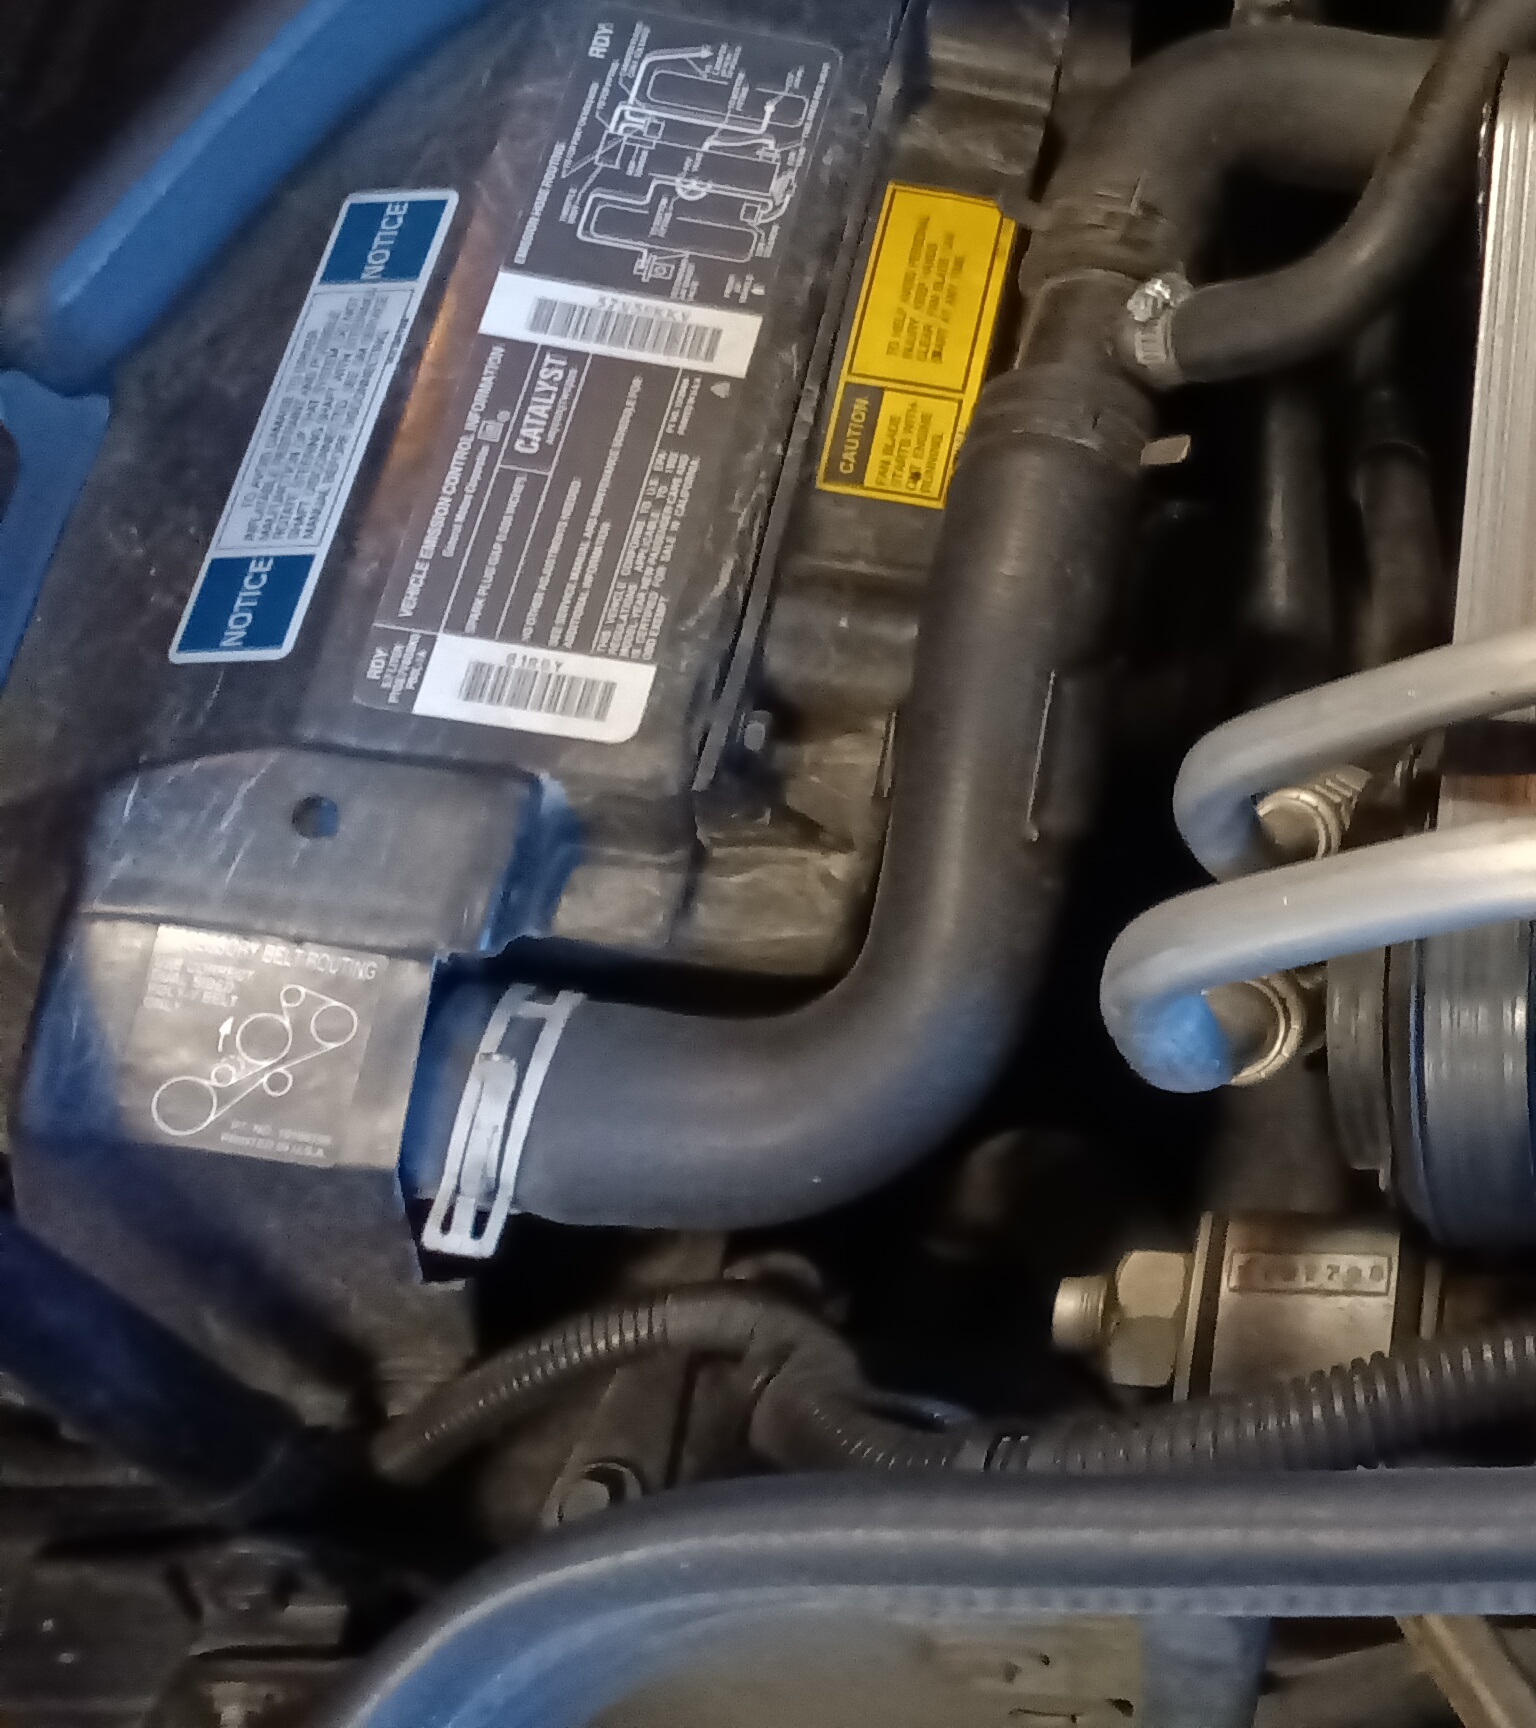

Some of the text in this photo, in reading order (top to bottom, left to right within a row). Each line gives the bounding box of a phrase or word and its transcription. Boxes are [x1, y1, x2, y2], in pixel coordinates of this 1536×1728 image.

[586, 20, 616, 59] RDY
[359, 201, 410, 280] NOTICE
[512, 352, 569, 455] CATALYST
[837, 397, 870, 474] CAUTION
[910, 411, 933, 459] ENGINE
[397, 560, 430, 617] VEHICLE
[417, 496, 453, 559] EMISSION
[440, 432, 475, 495] CONTROL
[464, 344, 506, 430] INFORMATION
[873, 414, 901, 485] FAN BLADE
[888, 437, 912, 488] STARTS
[219, 558, 274, 646] NOTICE
[365, 646, 390, 679] RDY
[260, 943, 305, 968] BELT
[304, 951, 379, 980] ROUTING
